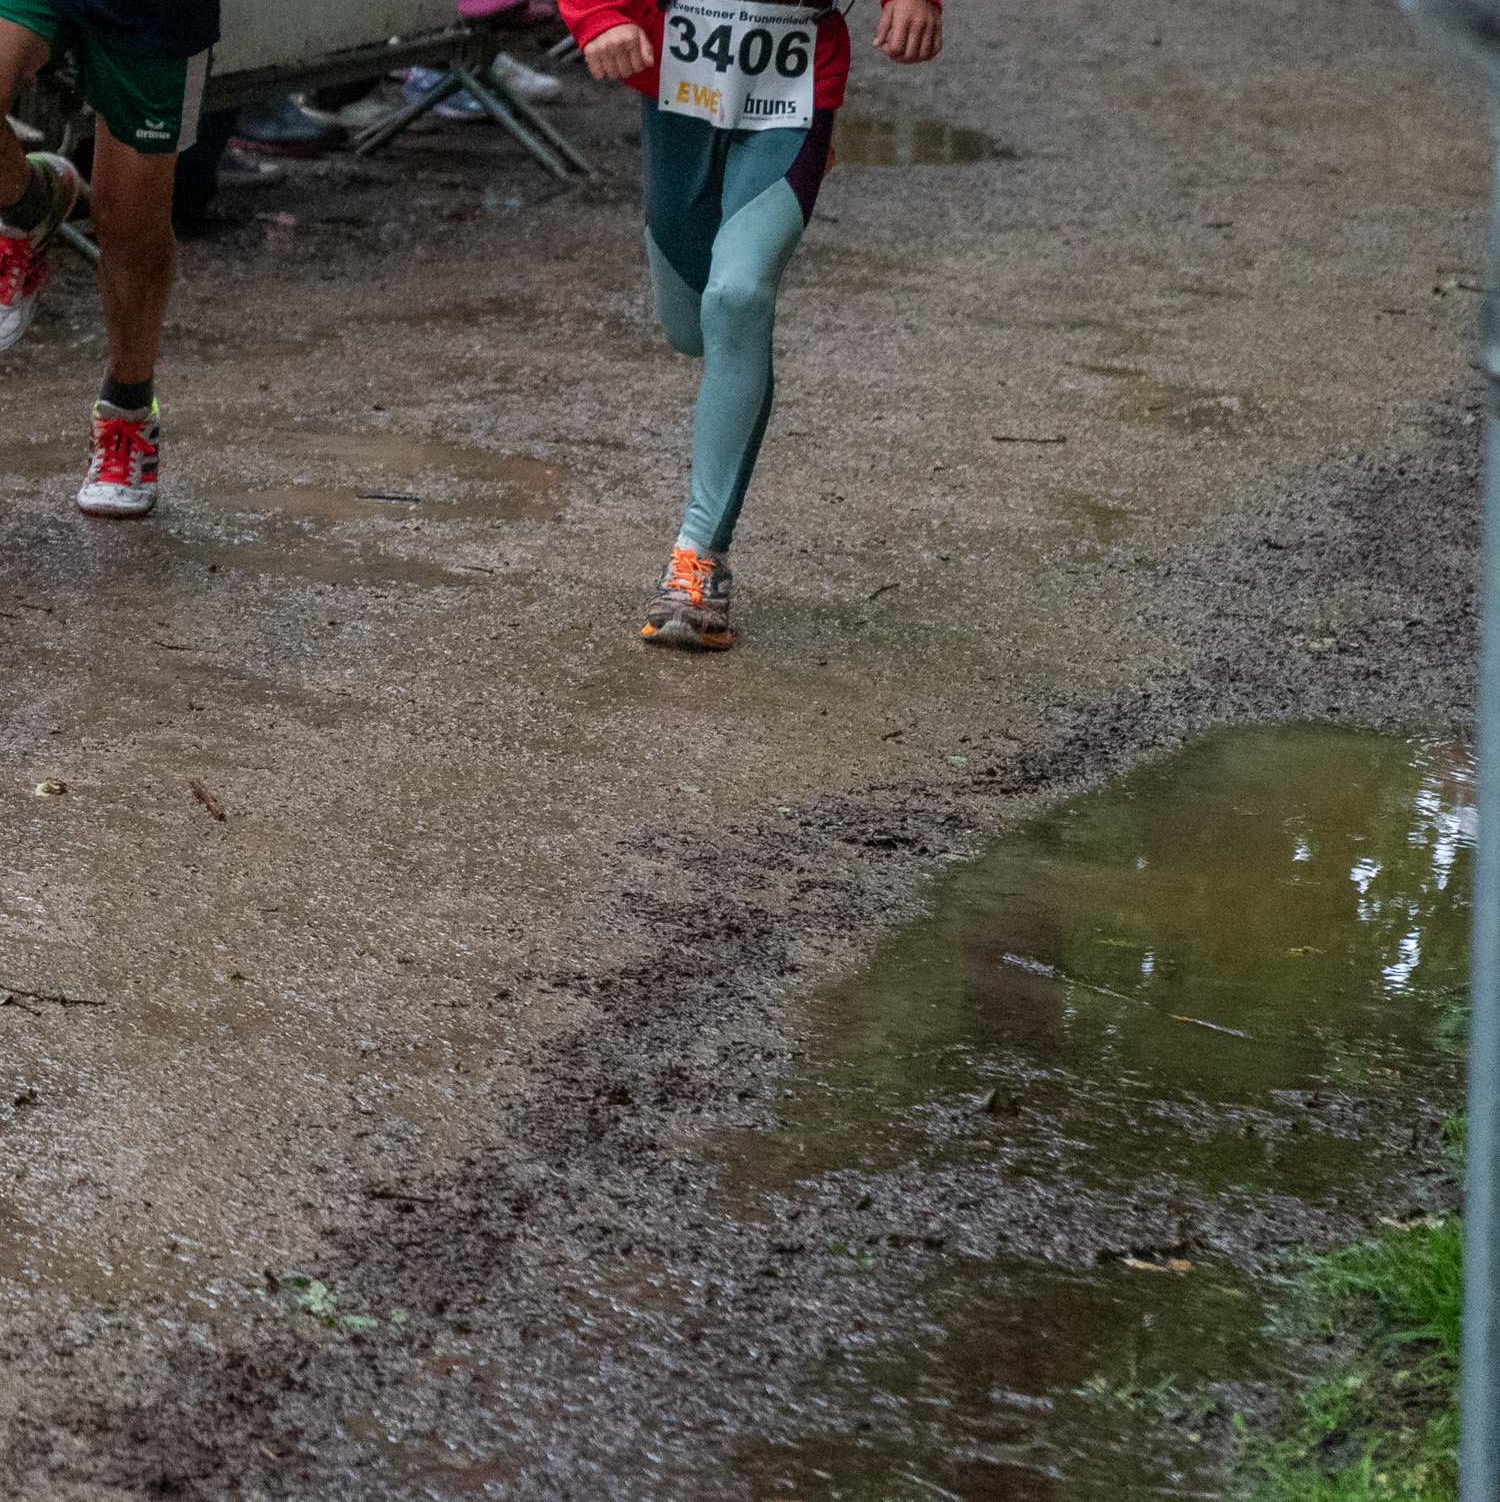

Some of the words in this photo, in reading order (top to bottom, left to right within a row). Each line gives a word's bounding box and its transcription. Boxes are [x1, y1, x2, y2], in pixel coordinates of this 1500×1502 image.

[738, 11, 811, 26] Brunnenlauf
[669, 15, 811, 78] 3406
[676, 80, 722, 114] EWE
[744, 92, 796, 115] bruns
